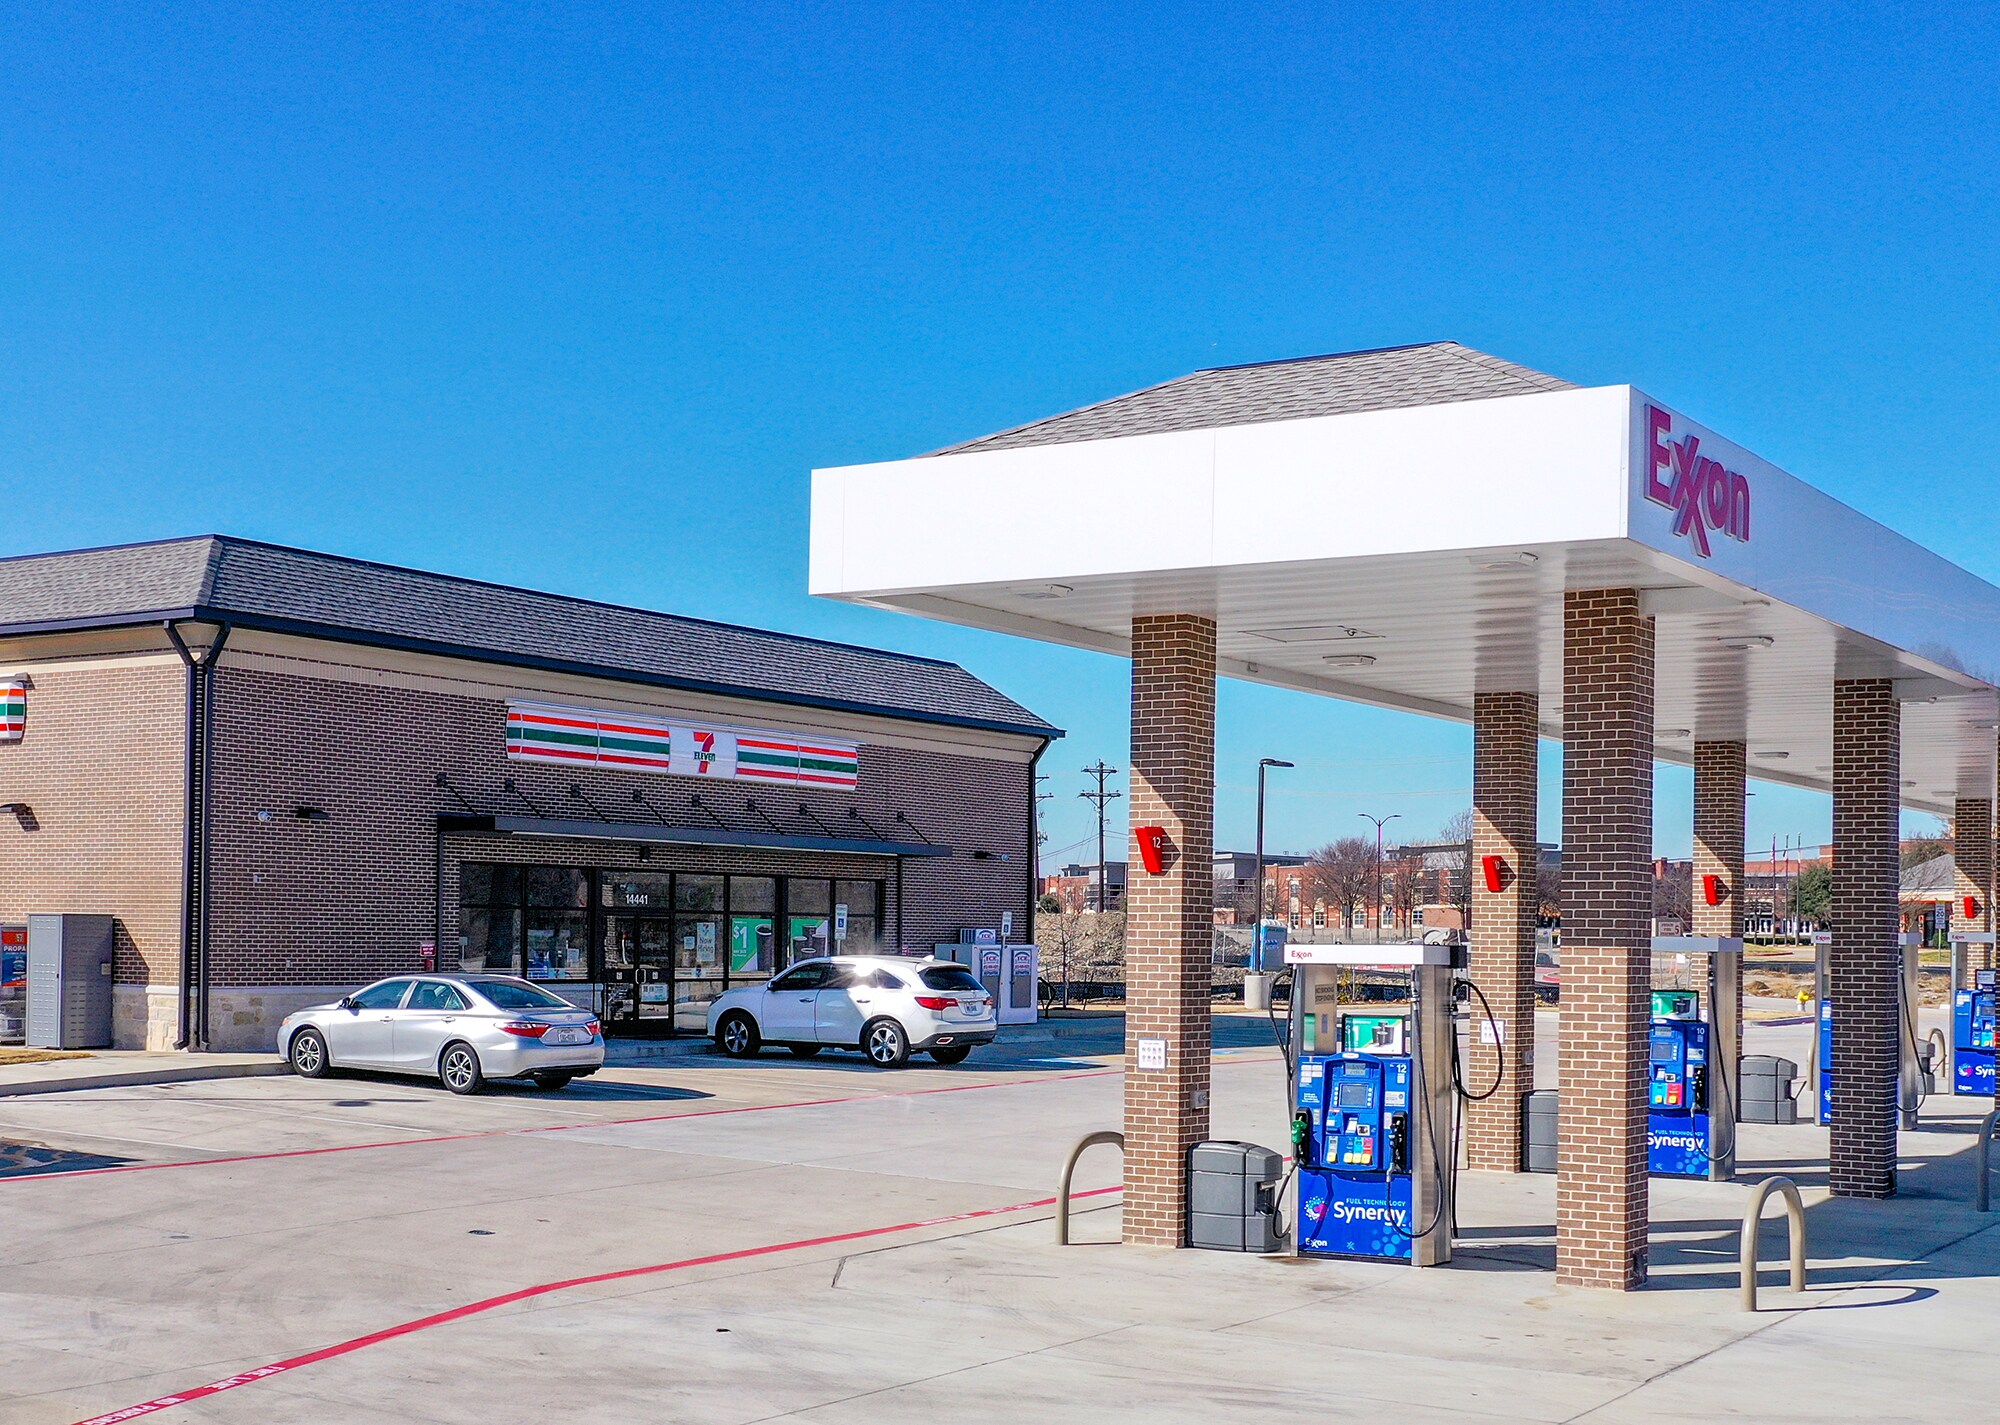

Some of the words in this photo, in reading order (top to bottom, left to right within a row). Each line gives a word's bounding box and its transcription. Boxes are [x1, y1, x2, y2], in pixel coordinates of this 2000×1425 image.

[1643, 403, 1750, 557] Exxon
[693, 731, 714, 774] 7
[1152, 836, 1161, 848] 12
[625, 893, 648, 905] 14441
[733, 925, 748, 949] $1
[1291, 950, 1312, 960] Exxon
[1696, 1027, 1705, 1035] 10
[1396, 1064, 1407, 1074] 12
[1647, 1132, 1705, 1152] Synergy
[1333, 1201, 1406, 1227] Synergy
[1305, 1238, 1328, 1248] Exxon
